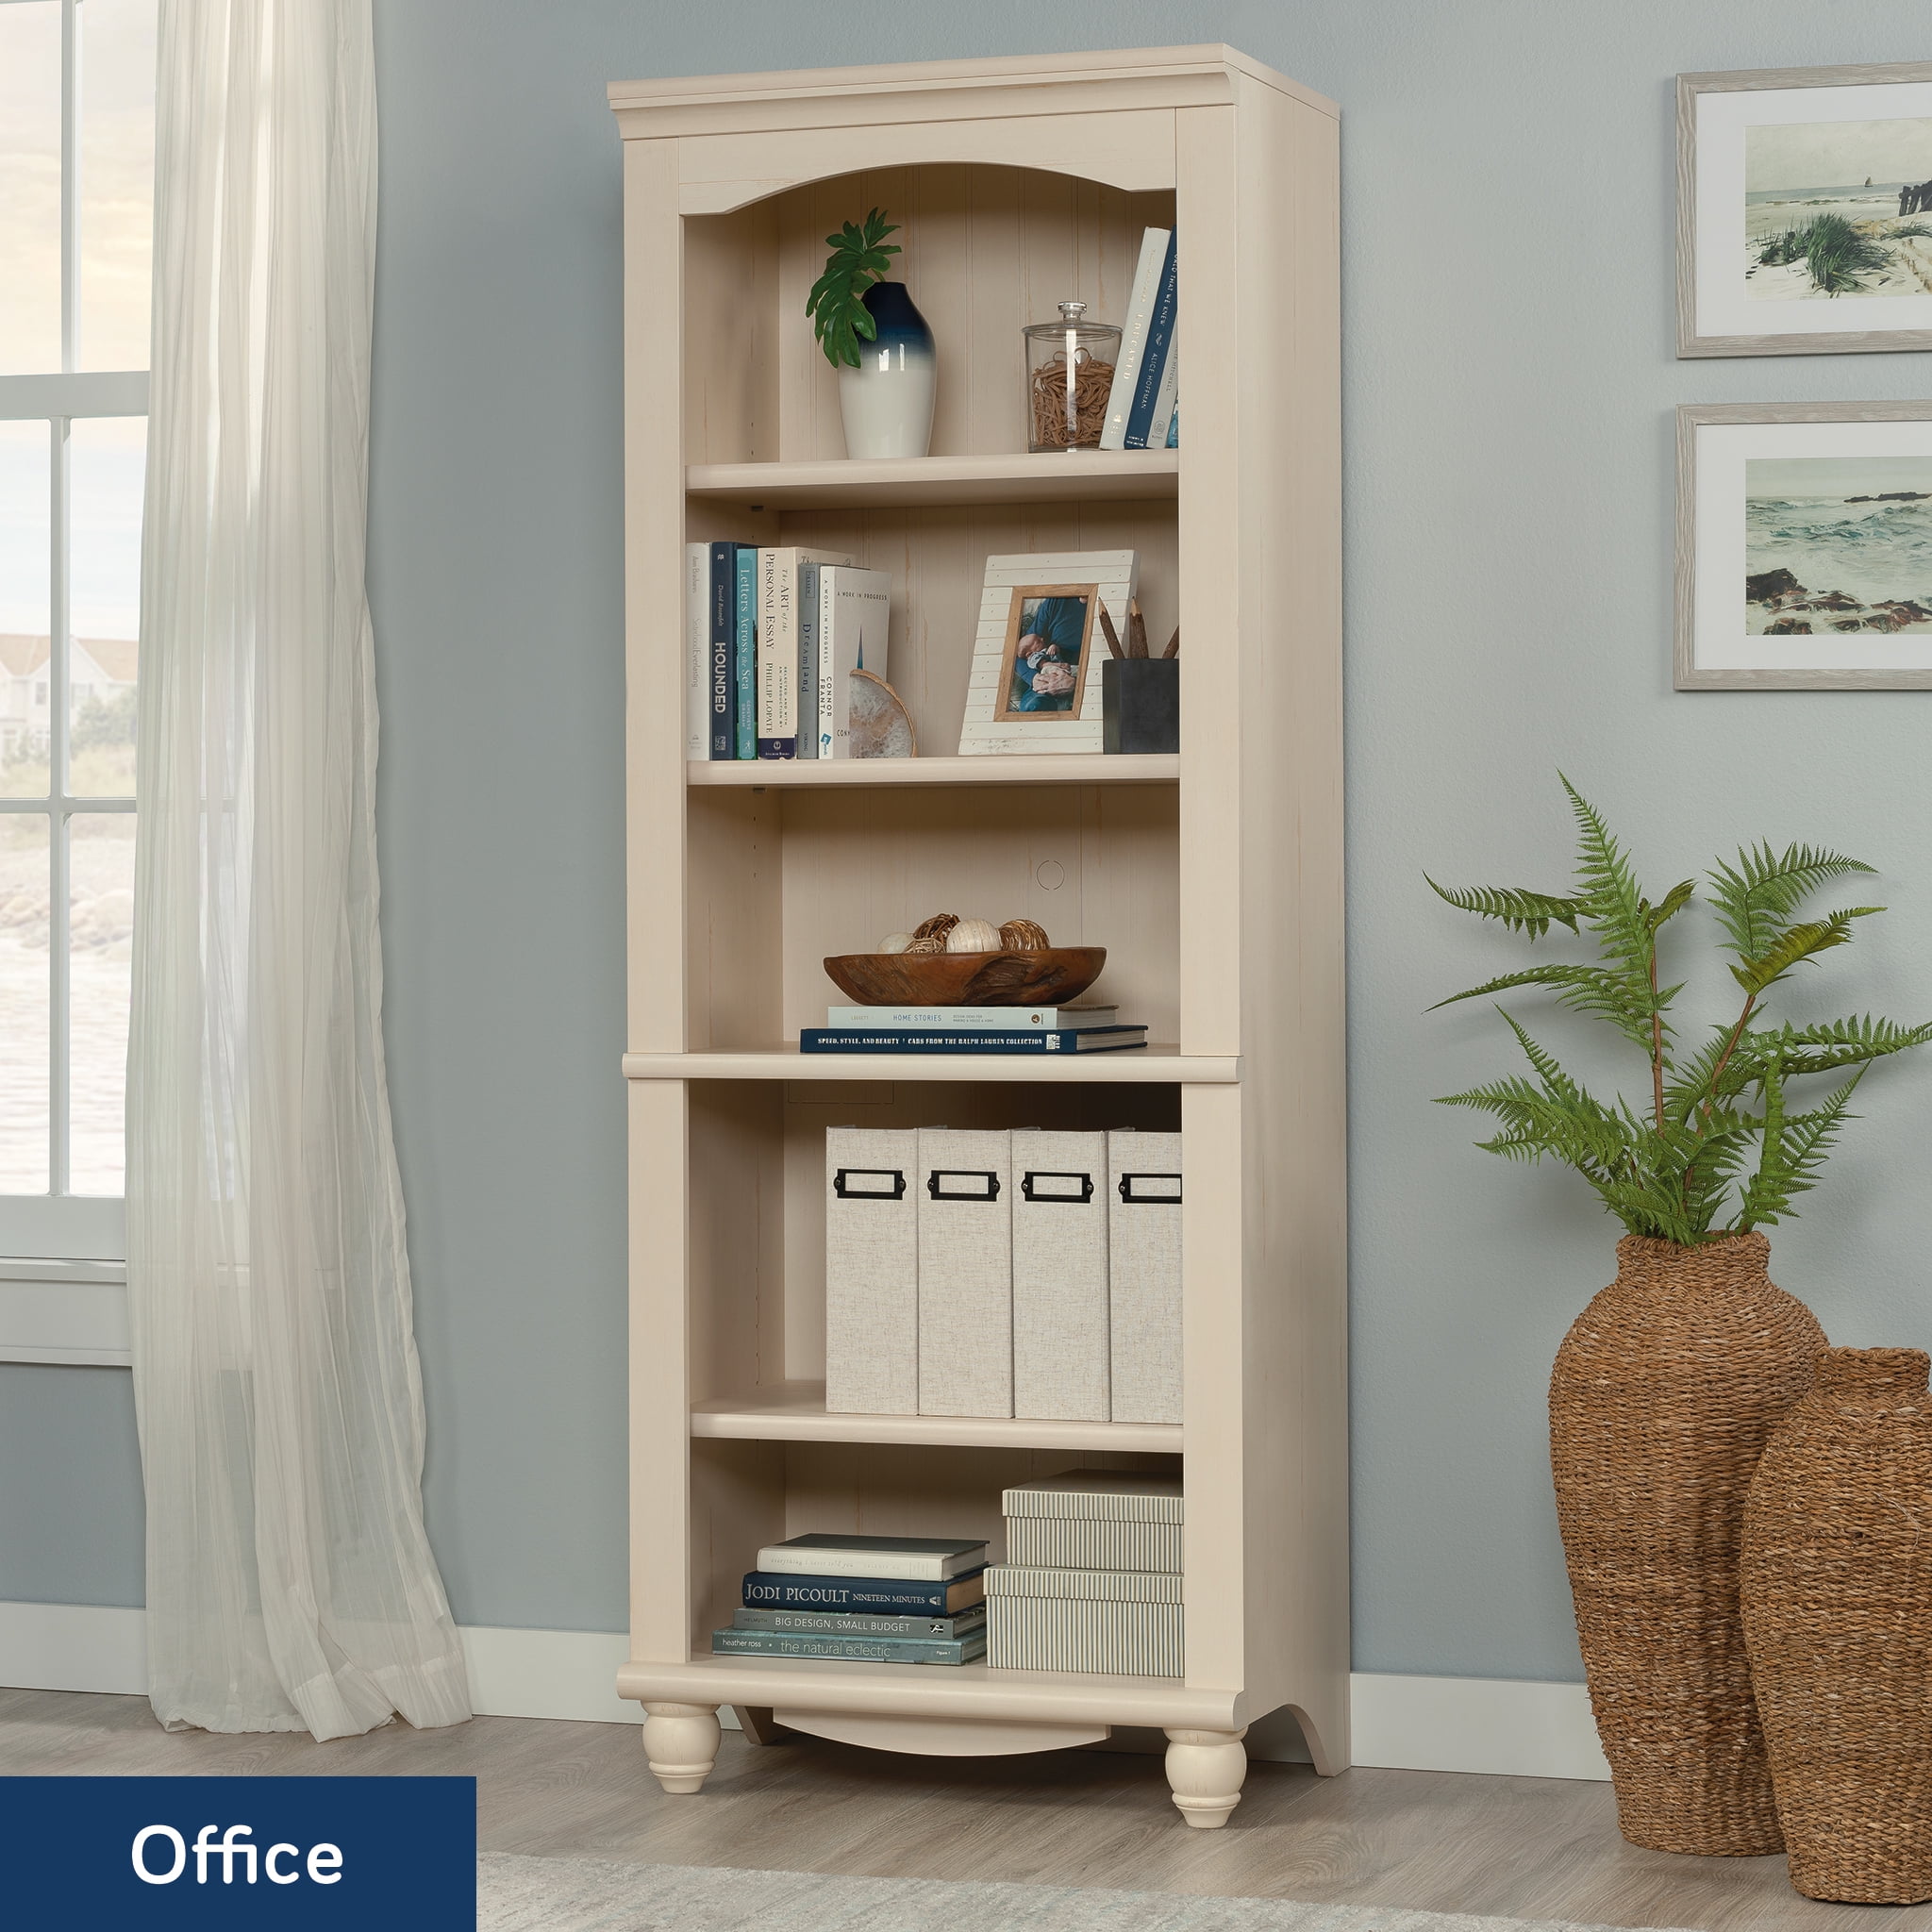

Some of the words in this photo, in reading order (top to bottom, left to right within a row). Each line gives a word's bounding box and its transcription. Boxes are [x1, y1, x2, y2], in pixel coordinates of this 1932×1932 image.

[1165, 293, 1173, 306] WE
[1159, 307, 1170, 326] KNEW
[1148, 352, 1158, 374] ALICE
[1141, 375, 1153, 409] HOFFMAN
[740, 569, 751, 612] Letters
[765, 553, 775, 612] PERSONAL
[780, 584, 790, 611] ART
[824, 614, 829, 623] IN
[740, 615, 751, 653] Across
[765, 615, 776, 650] ESSAY
[741, 656, 749, 667] the
[801, 624, 812, 692] Dreamland
[714, 641, 726, 714] HOUNDED
[741, 669, 751, 690] Sea
[765, 662, 774, 698] PHILLIP
[765, 699, 774, 734] LOPATE
[745, 1583, 781, 1600] JODI
[785, 1587, 850, 1604] PICOULT
[852, 1592, 891, 1603] NINETEEN
[891, 1595, 925, 1605] MINUTES
[774, 1617, 791, 1626] BIG
[794, 1618, 834, 1630] DESIGN,
[837, 1620, 868, 1631] SMALL
[871, 1622, 911, 1632] BUDGET
[722, 1638, 747, 1647] heather
[780, 1640, 800, 1653] the
[803, 1641, 842, 1655] natural
[845, 1643, 891, 1657] eclectic
